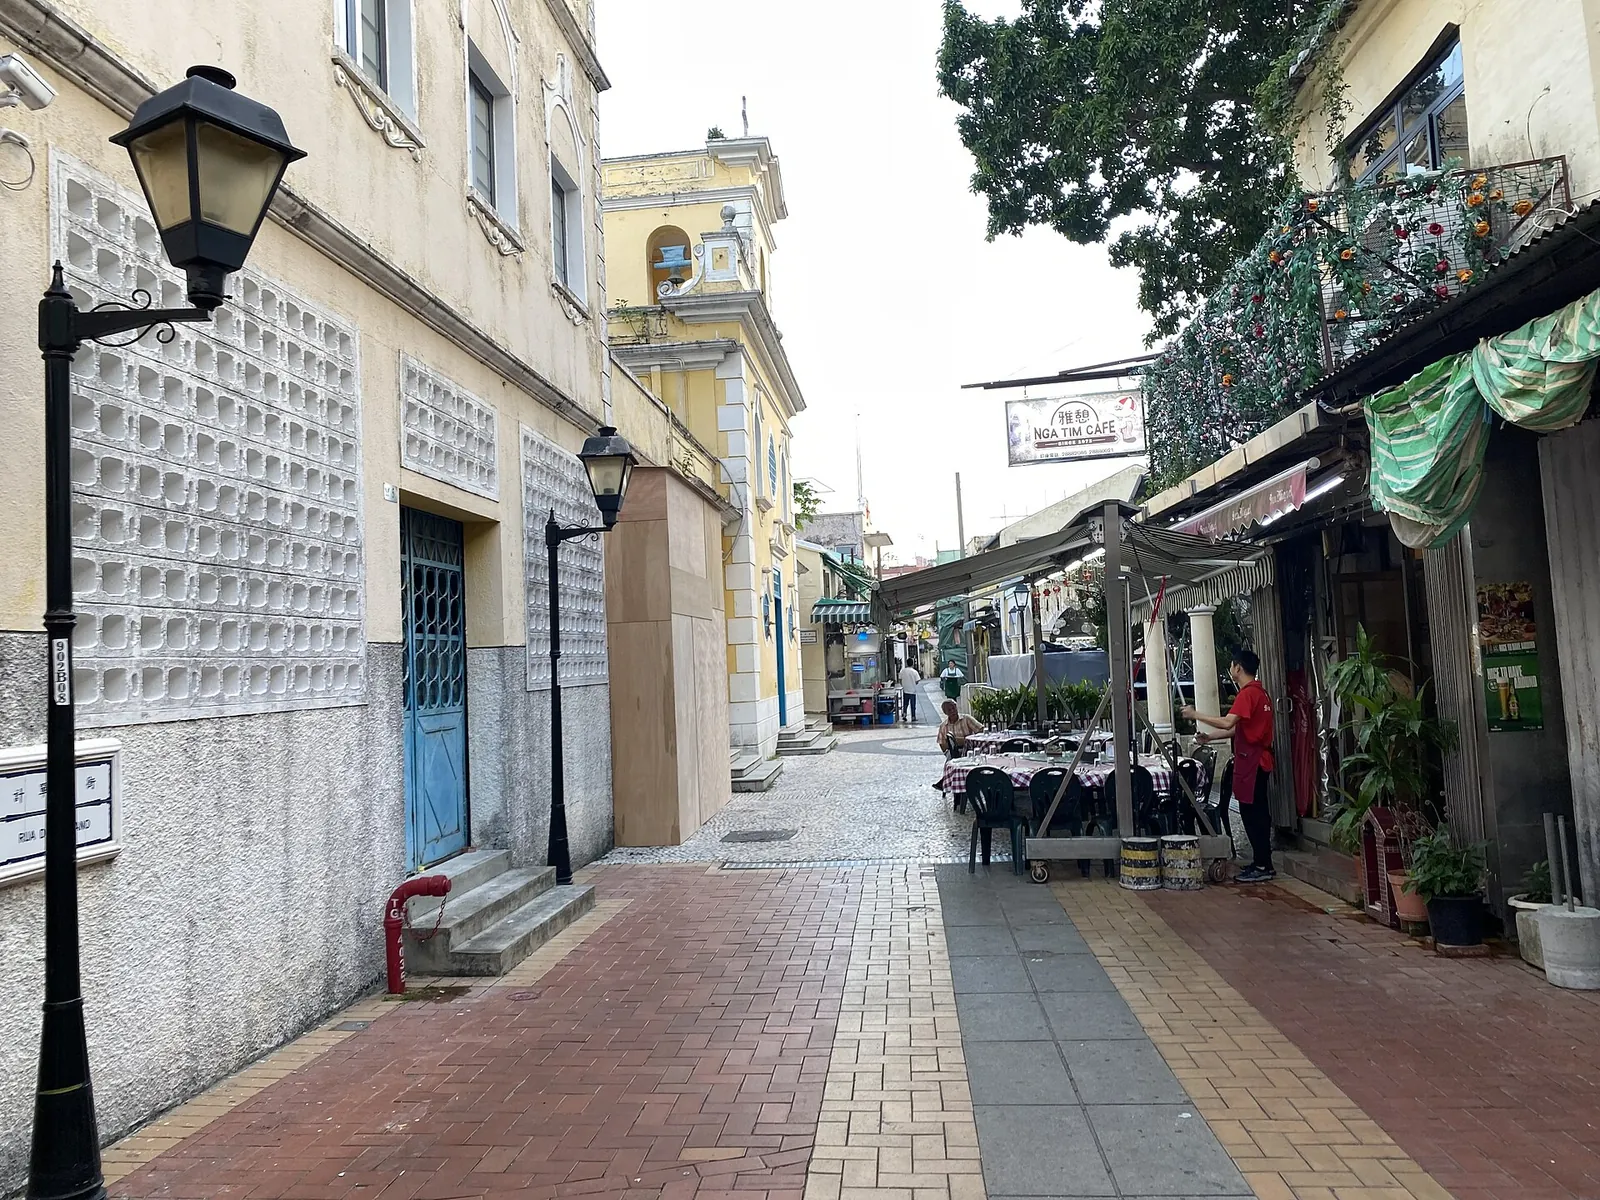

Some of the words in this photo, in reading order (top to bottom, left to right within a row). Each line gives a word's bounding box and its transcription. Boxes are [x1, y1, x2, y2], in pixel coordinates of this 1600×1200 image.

[1034, 427, 1058, 440] NGA
[1061, 425, 1082, 437] TIM
[1086, 420, 1116, 435] CAFE
[56, 641, 67, 704] 902B08
[18, 831, 37, 844] RUA
[39, 828, 47, 839] D
